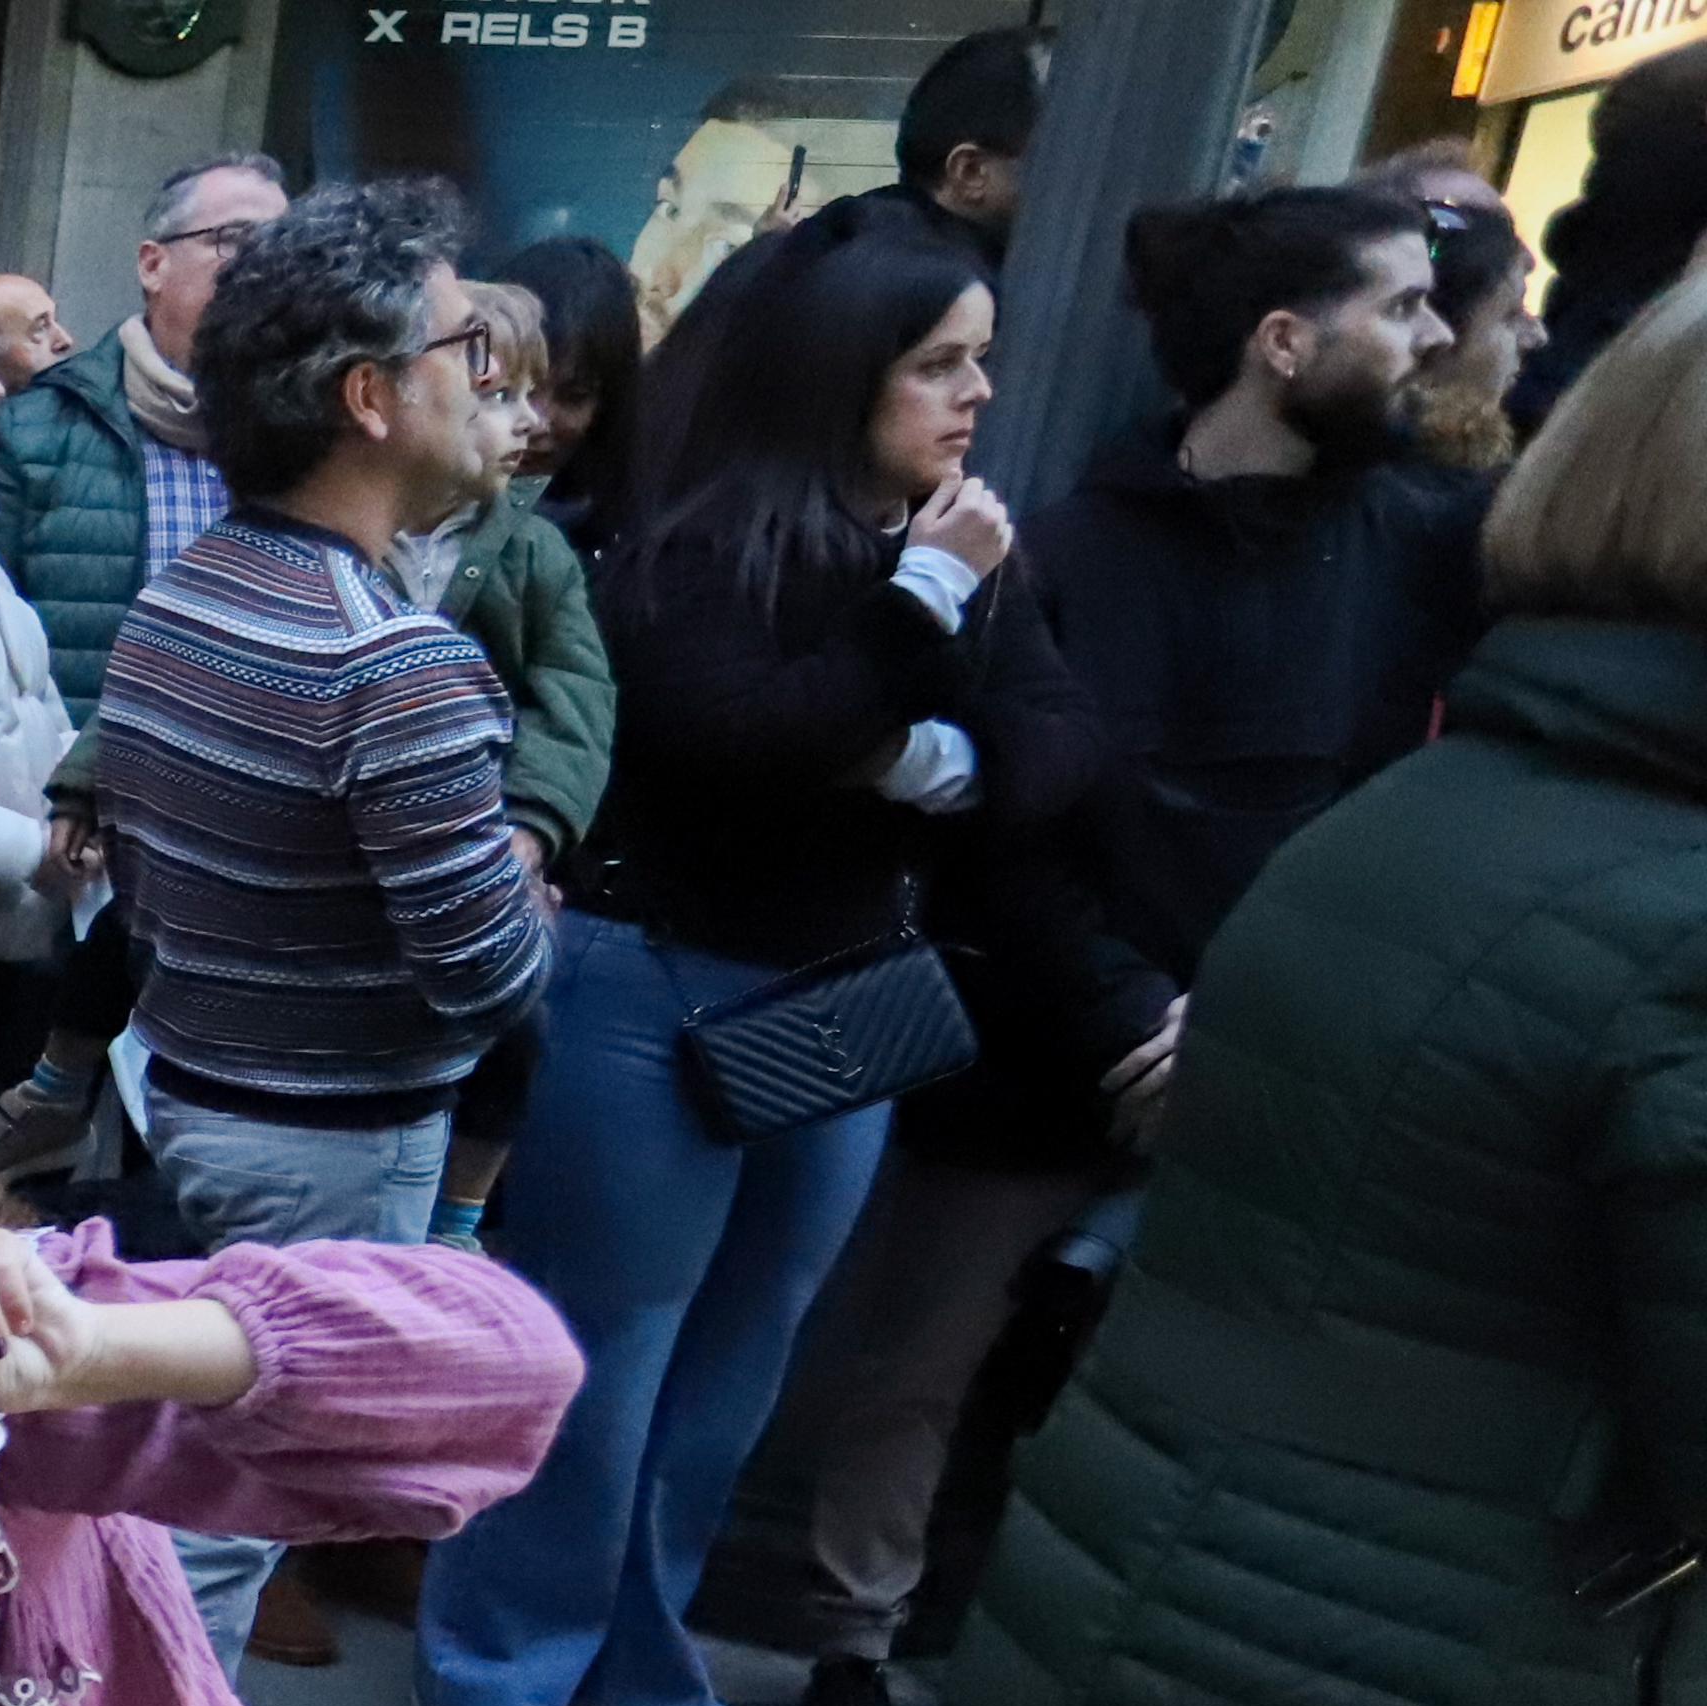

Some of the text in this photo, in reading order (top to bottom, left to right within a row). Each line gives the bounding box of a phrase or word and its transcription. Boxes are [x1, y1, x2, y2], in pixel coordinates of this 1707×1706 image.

[364, 9, 648, 49] X RELS B
